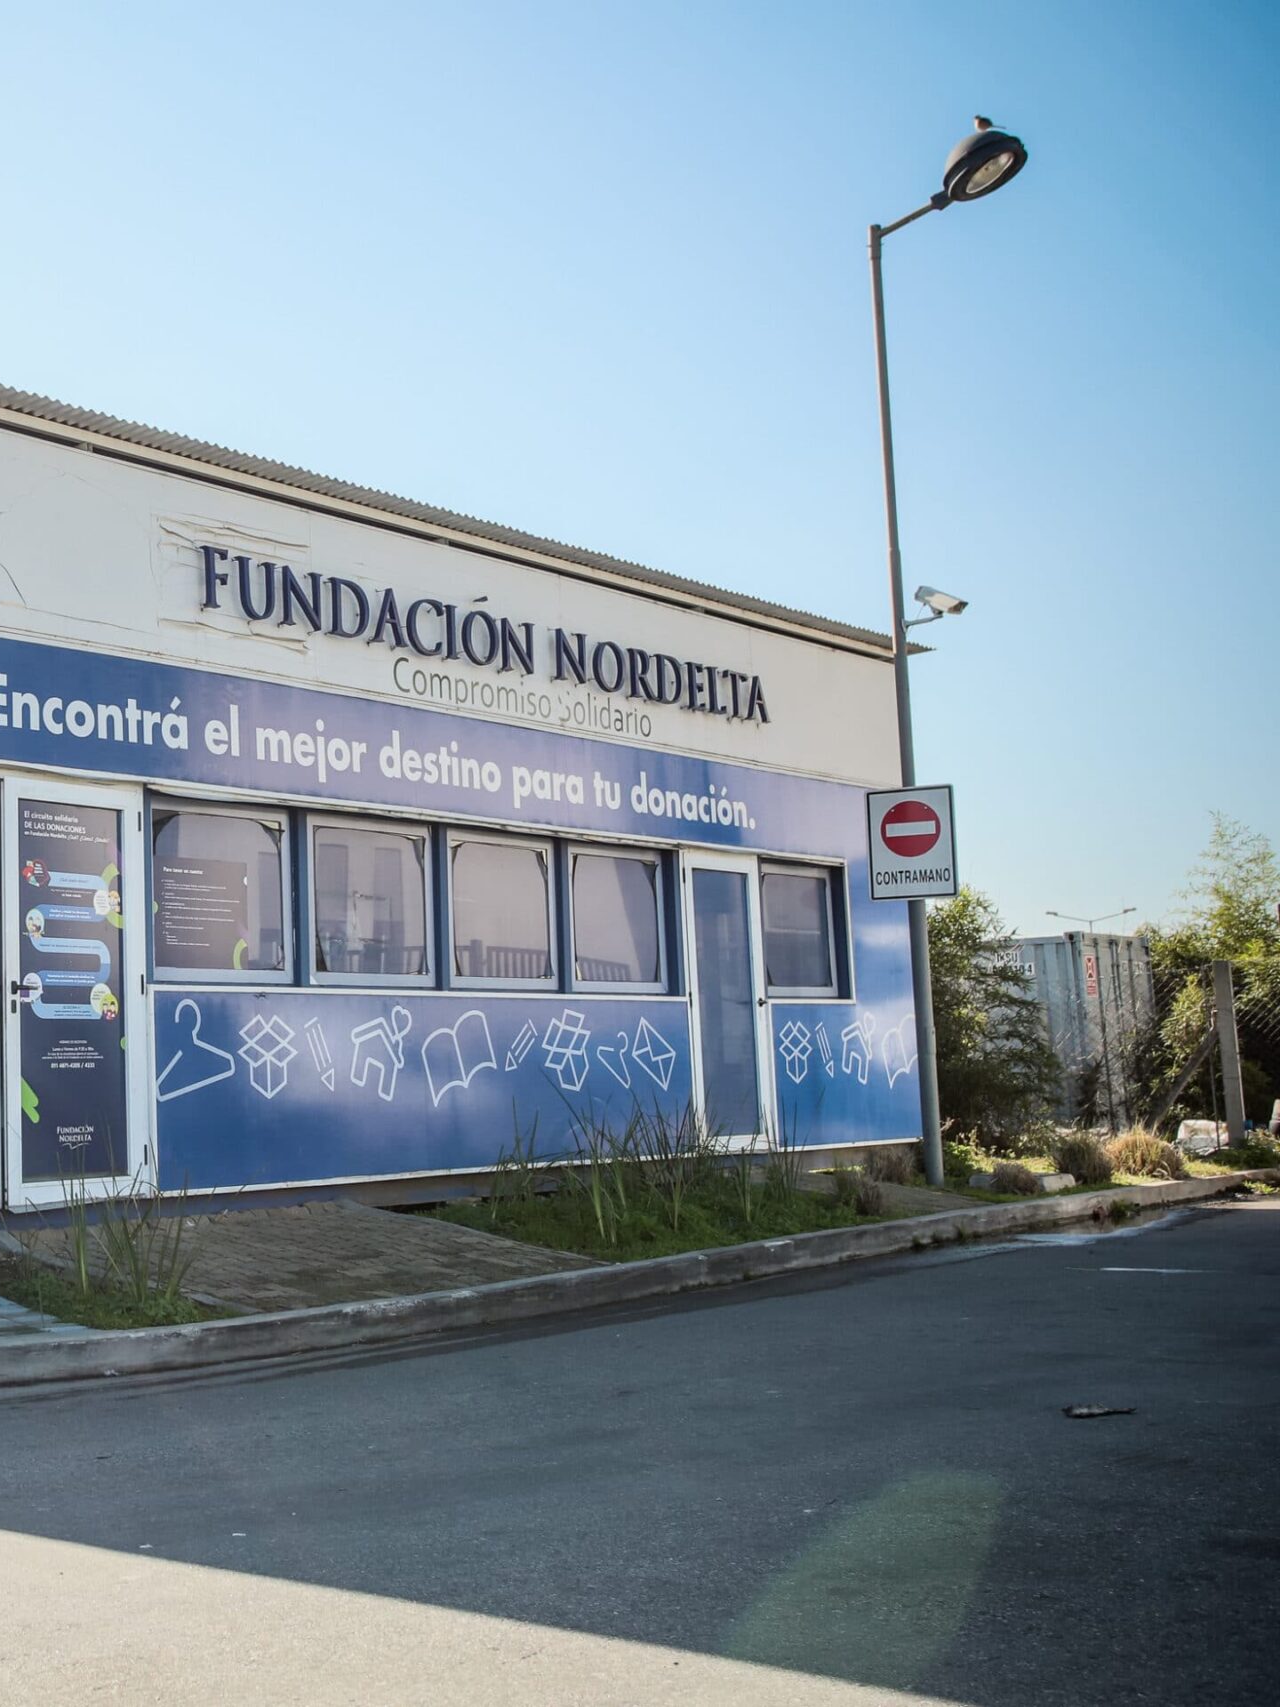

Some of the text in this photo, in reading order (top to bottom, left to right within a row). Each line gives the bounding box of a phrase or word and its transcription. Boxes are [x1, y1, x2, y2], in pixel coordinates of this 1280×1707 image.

[199, 544, 771, 725] FUNDACIÓN NORDELTA
[393, 656, 552, 719] Compromiso
[204, 704, 240, 757] el
[255, 718, 368, 783] mejor
[379, 729, 502, 793] destino
[511, 766, 584, 808] para
[592, 771, 620, 810] tu
[630, 771, 756, 830] donación.
[24, 821, 86, 834] DE LAS DONACIONES
[875, 867, 951, 885] CONTRAMANO
